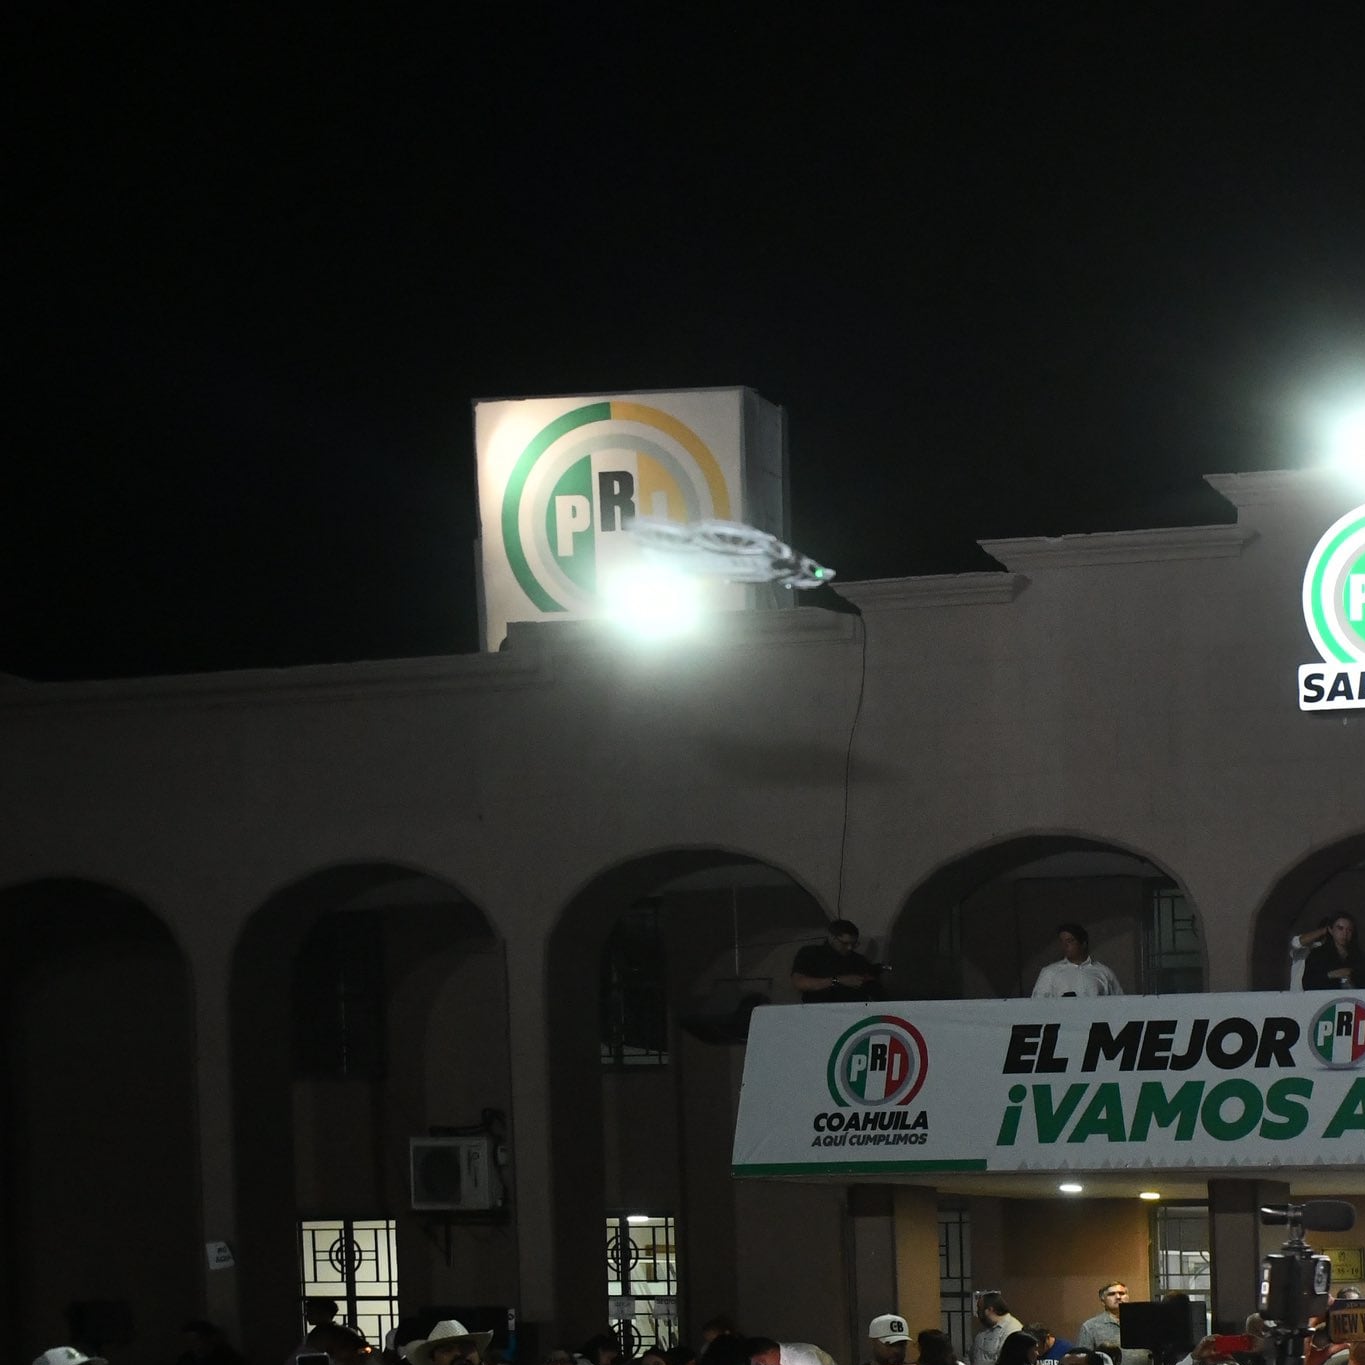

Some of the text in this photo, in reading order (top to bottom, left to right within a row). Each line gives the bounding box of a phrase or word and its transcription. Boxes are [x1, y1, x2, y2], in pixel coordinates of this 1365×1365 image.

[849, 1043, 901, 1082] PRI
[1002, 1023, 1069, 1075] EL
[1081, 1017, 1300, 1073] MEJOR
[813, 1110, 929, 1133] COAHUILA
[996, 1077, 1314, 1146] ¡VAMOS
[811, 1131, 928, 1148] AQUÍ CUMPLIMOS
